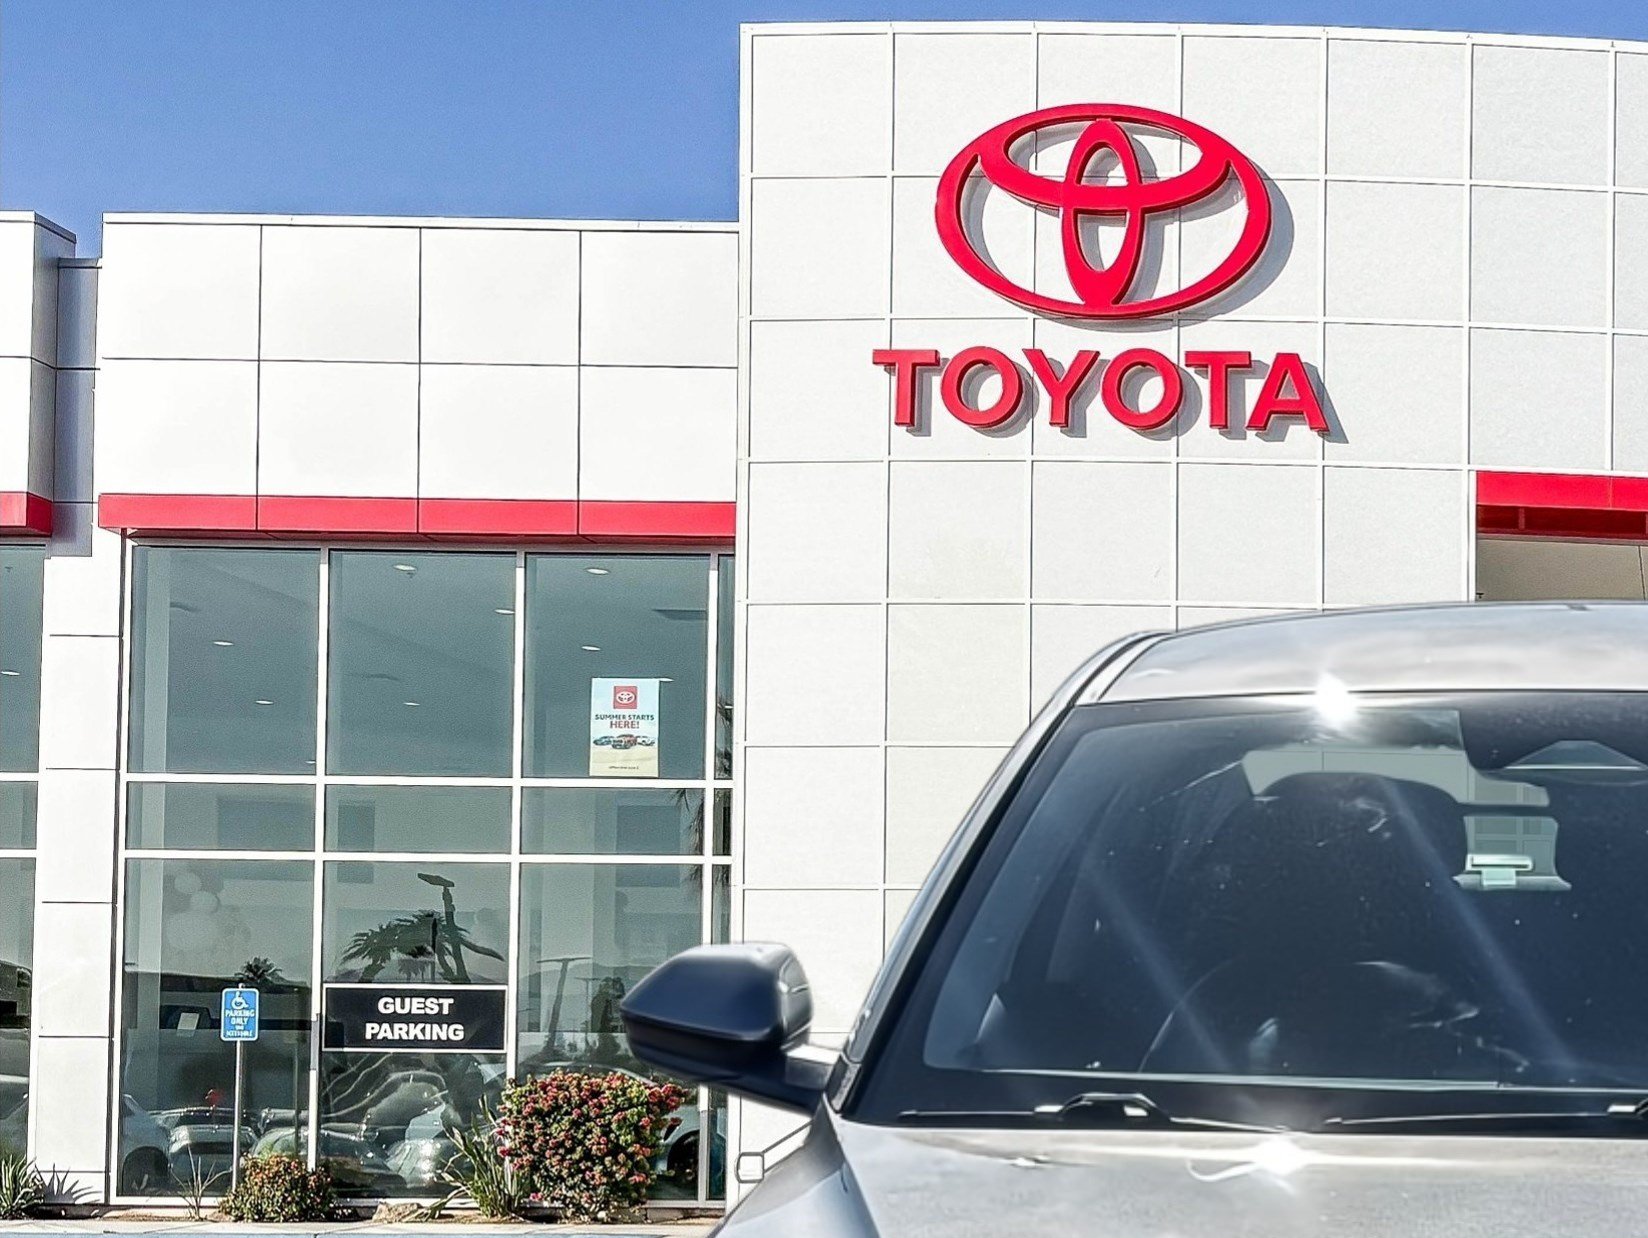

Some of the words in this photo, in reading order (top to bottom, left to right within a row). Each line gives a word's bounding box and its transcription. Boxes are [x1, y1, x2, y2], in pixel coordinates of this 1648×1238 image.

[872, 346, 1328, 433] TOYOTA
[594, 713, 627, 721] SUMMER
[609, 720, 640, 729] HERE!
[377, 997, 454, 1015] GUEST
[225, 1009, 255, 1017] PARKING
[230, 1017, 249, 1025] ONLY
[364, 1022, 465, 1041] PARKING
